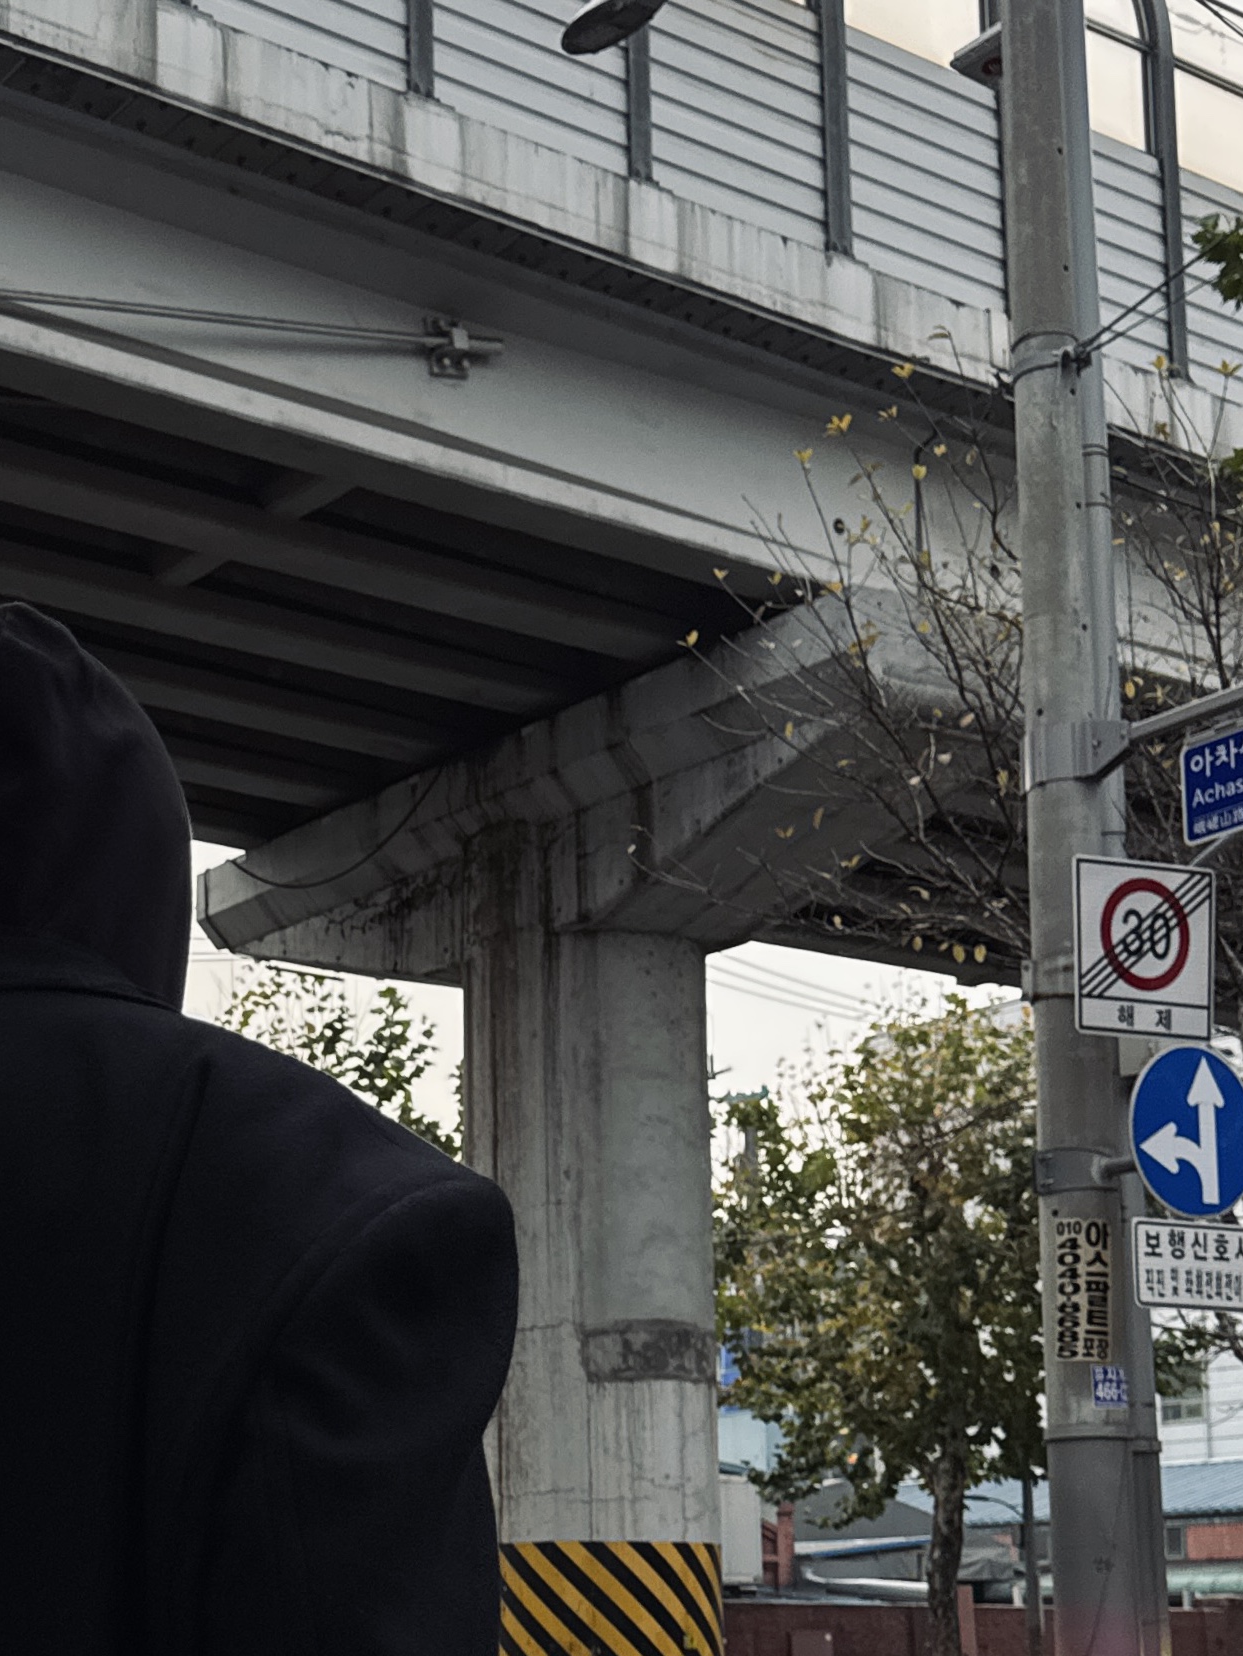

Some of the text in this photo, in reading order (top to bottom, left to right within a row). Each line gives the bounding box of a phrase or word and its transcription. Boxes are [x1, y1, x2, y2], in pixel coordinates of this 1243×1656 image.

[1190, 739, 1243, 777] 아차
[1123, 908, 1171, 960] 30
[1057, 1220, 1082, 1236] 010
